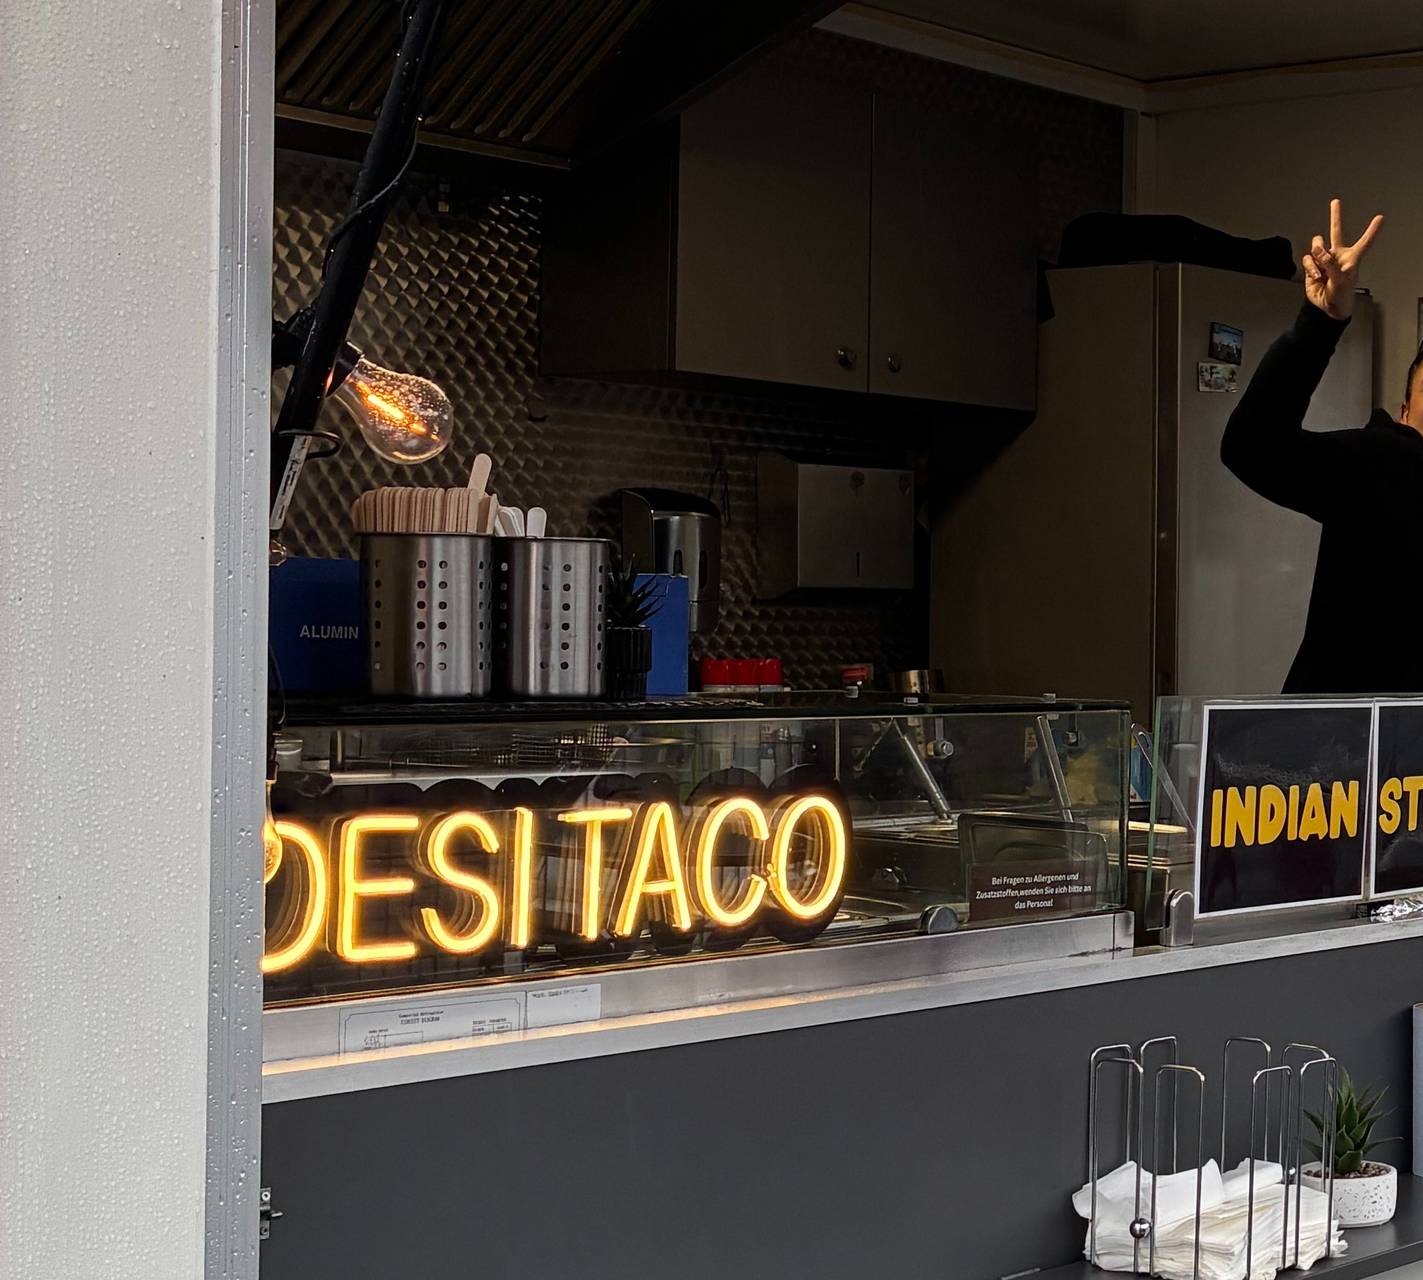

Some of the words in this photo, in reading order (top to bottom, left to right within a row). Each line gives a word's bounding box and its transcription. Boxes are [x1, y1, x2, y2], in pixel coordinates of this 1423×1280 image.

[299, 624, 360, 640] ALUMIN
[1209, 779, 1360, 849] INDIAN
[991, 876, 1003, 886] Bei
[1003, 876, 1025, 887] Fragen
[1025, 876, 1033, 884] zu
[1033, 874, 1067, 885] Allergenen
[1067, 872, 1080, 882] und
[1045, 886, 1055, 896] Sie
[1055, 885, 1068, 895] sich
[1068, 885, 1083, 894] bitte
[1083, 885, 1092, 893] an
[1014, 900, 1026, 910] das
